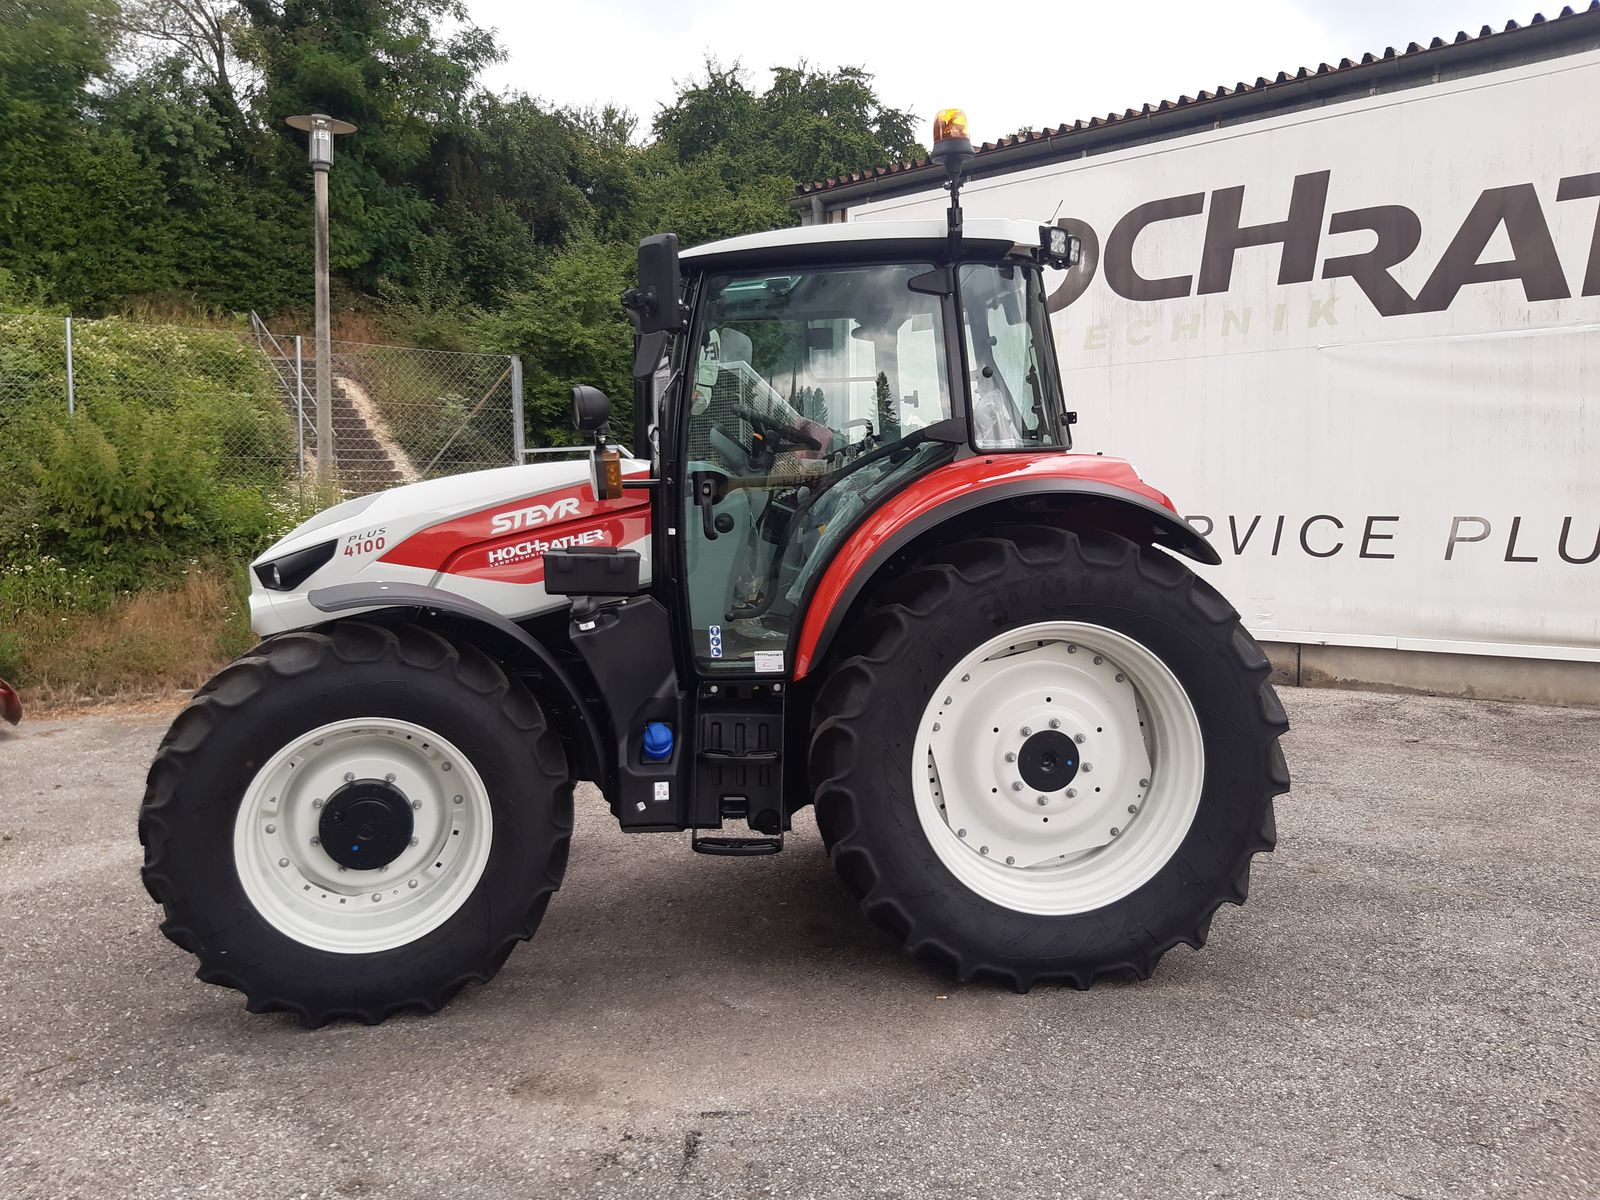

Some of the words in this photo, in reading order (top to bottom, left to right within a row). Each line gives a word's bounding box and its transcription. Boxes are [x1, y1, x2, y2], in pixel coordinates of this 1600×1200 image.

[491, 497, 581, 535] STEYR
[344, 536, 385, 557] 4100
[348, 526, 387, 543] PLUS
[489, 529, 605, 563] HOCHRATHER
